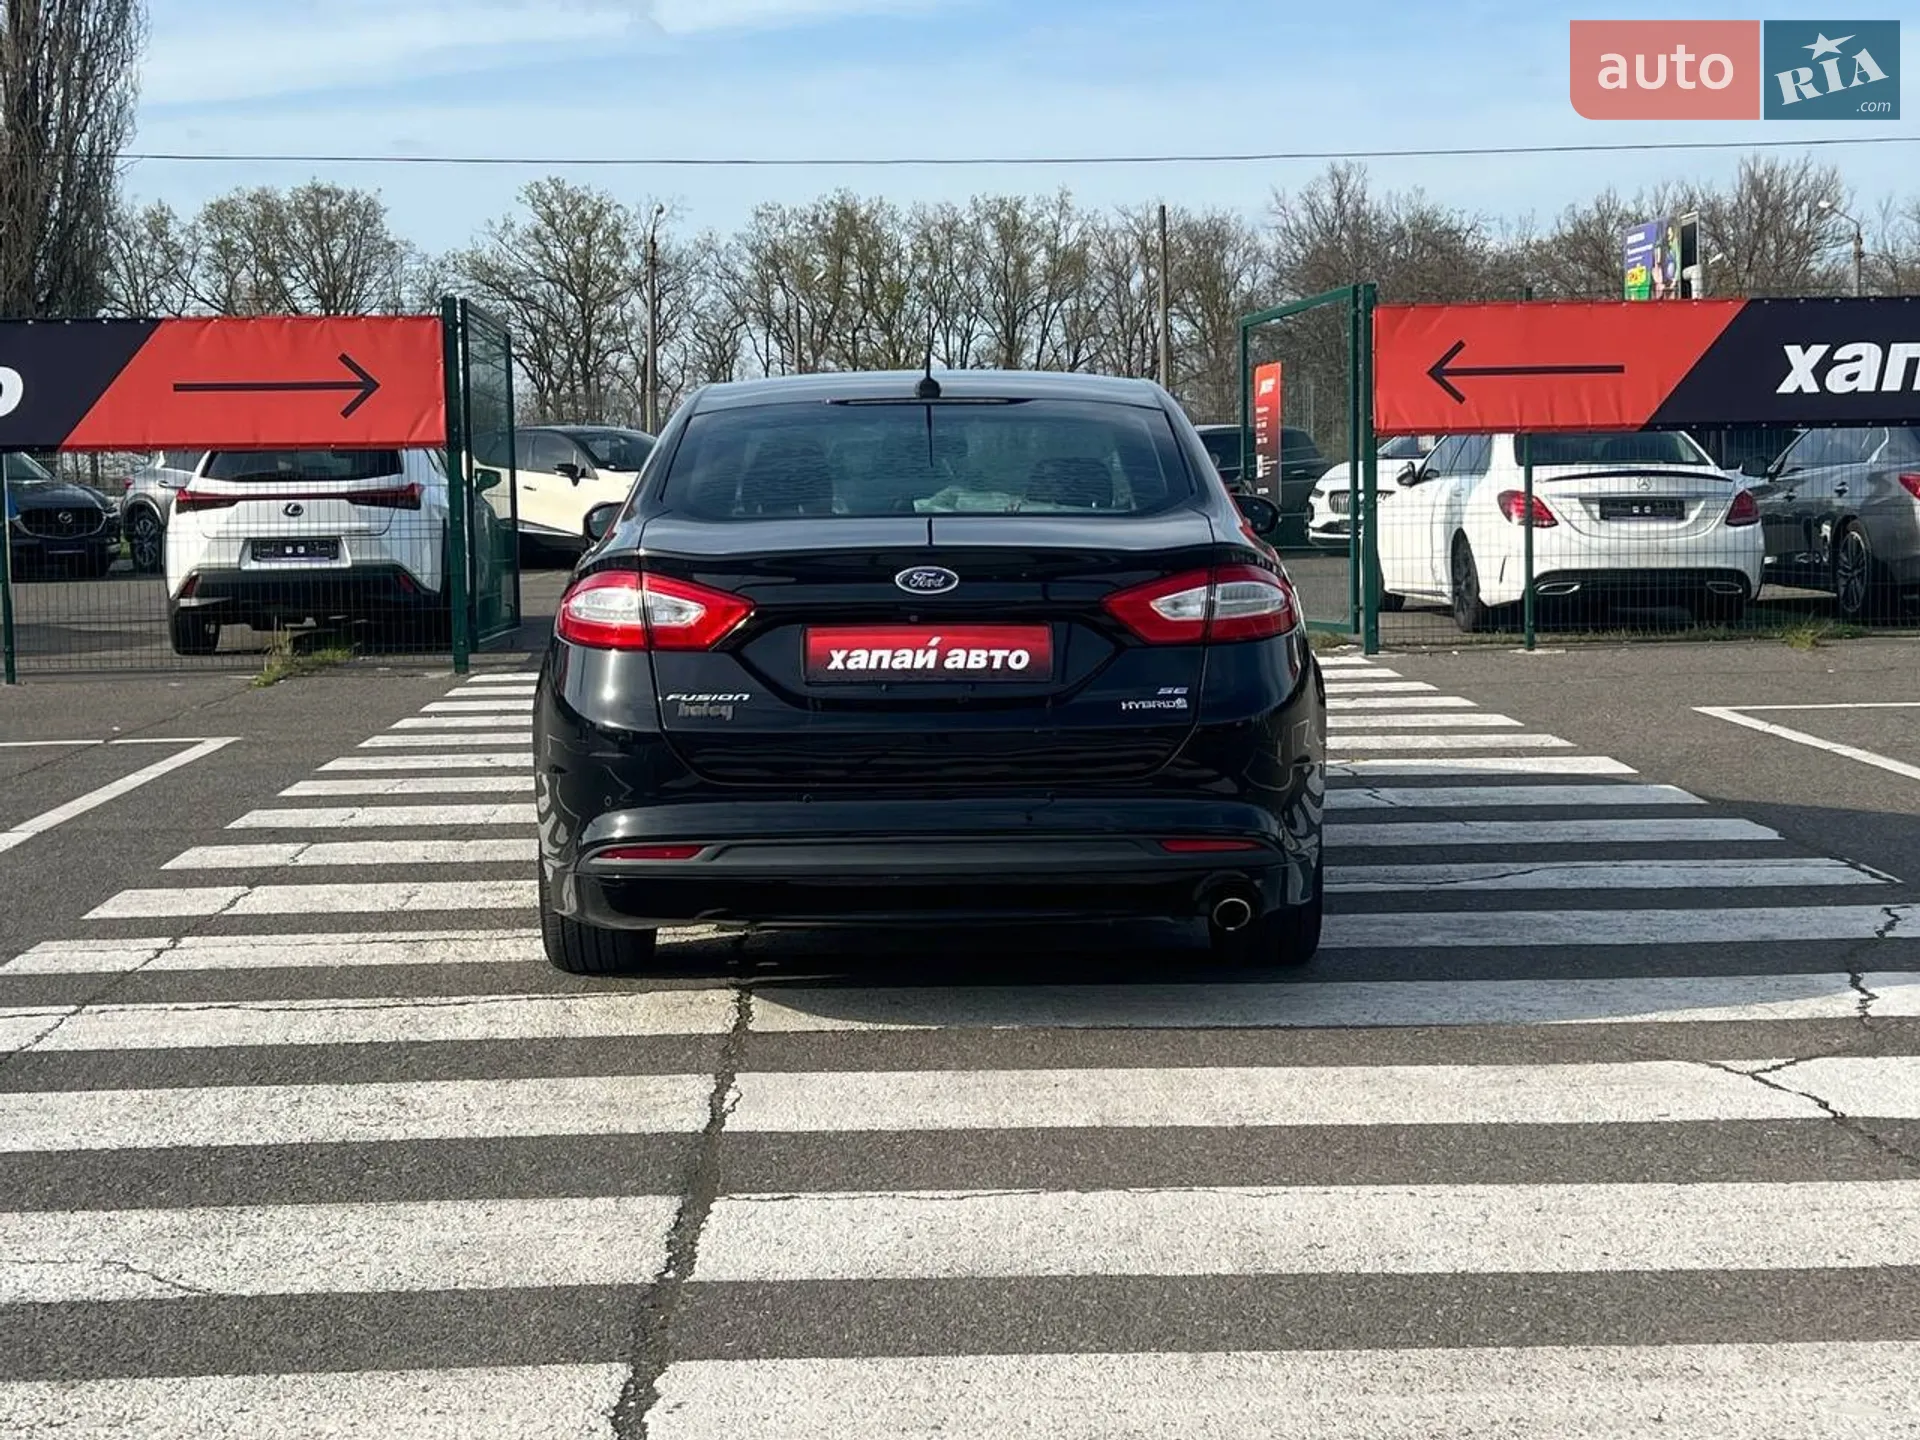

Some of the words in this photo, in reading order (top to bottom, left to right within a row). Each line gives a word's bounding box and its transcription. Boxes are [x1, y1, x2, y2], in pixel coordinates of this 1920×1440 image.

[909, 571, 945, 587] Ford
[827, 636, 942, 670] хапай
[943, 648, 1030, 670] авто
[1157, 686, 1189, 695] SE
[665, 693, 750, 701] FUSION
[1121, 700, 1176, 710] HYBRID
